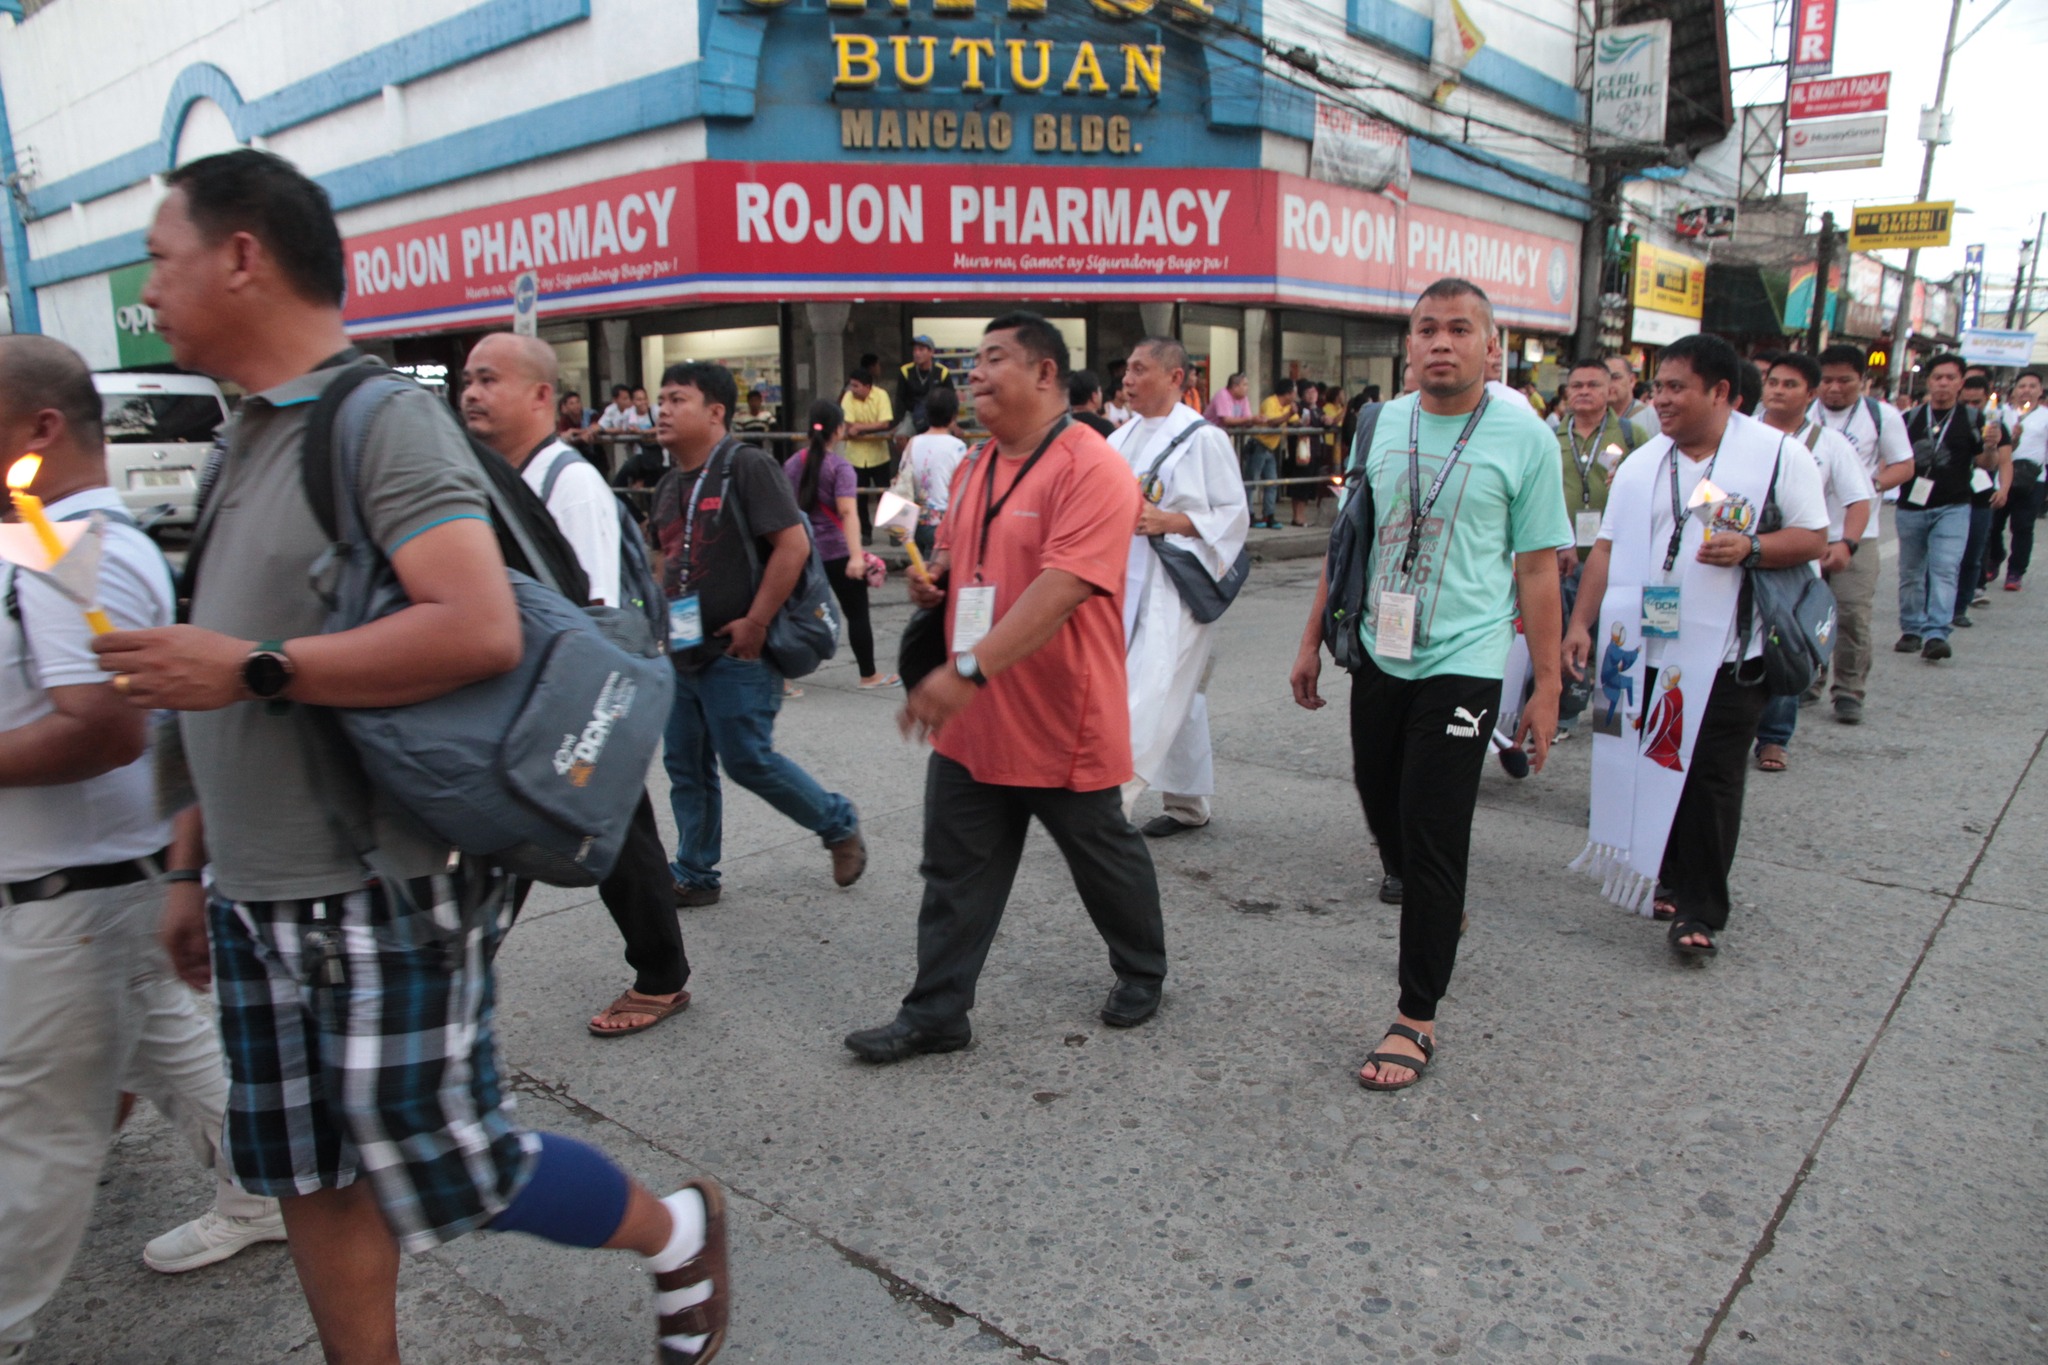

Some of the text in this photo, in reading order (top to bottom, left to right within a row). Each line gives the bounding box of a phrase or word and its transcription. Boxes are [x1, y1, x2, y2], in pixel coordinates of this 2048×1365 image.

[831, 33, 1166, 96] BUTUAN
[1598, 71, 1639, 88] CEBU
[1597, 83, 1660, 102] PACIFIC
[841, 108, 1143, 153] MANCAO BLDG.
[735, 182, 1231, 246] ROJON PHARMACY
[1858, 210, 1932, 226] WESTERN
[1878, 220, 1931, 233] UNION
[353, 187, 677, 297] ROJON PHARMACY
[1283, 193, 1542, 288] ROJON PHARMACY
[953, 252, 992, 268] Mura
[1020, 254, 1065, 269] Gamot
[1067, 256, 1084, 273] ay
[1086, 252, 1165, 273] Siguradong
[1166, 254, 1201, 273] Bago
[117, 303, 157, 335] opp
[1427, 481, 1443, 500] DCM
[1655, 601, 1678, 611] DCM
[1446, 724, 1475, 738] PUMA
